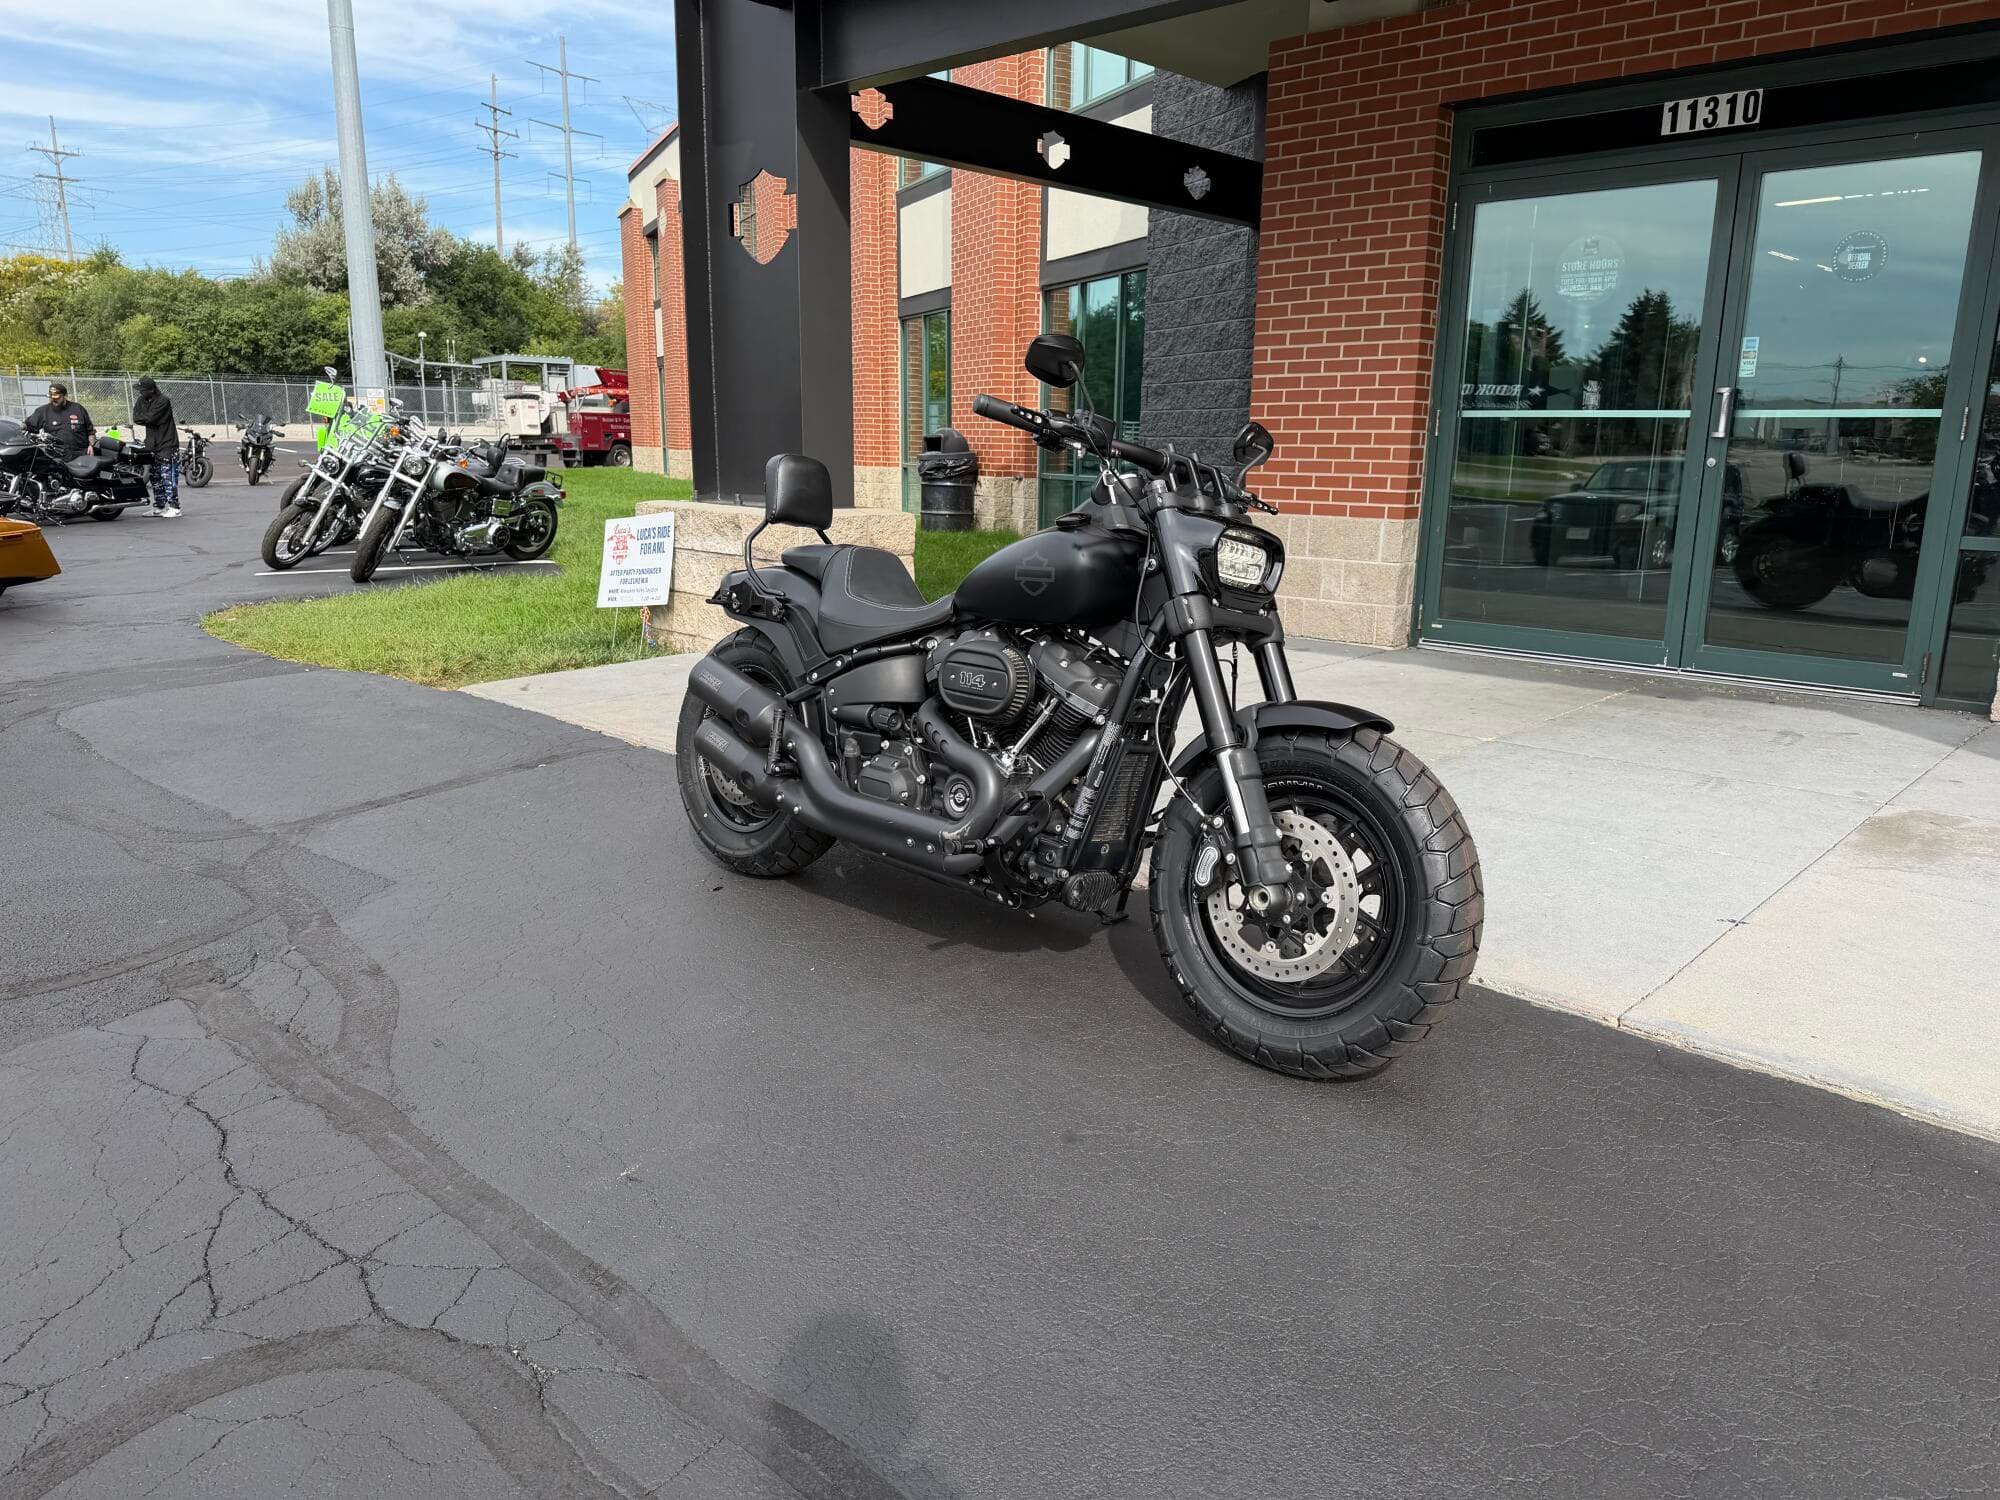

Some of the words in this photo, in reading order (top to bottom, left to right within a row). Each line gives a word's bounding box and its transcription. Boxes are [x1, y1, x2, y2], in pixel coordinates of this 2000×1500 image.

[1667, 90, 1761, 133] 11310
[1561, 260, 1587, 272] STORE
[1589, 258, 1618, 270] HOURS
[315, 392, 339, 402] SALE
[636, 527, 656, 541] LUCA'S
[657, 525, 671, 539] RIDE
[640, 543, 652, 555] FOR
[960, 671, 986, 688] 114
